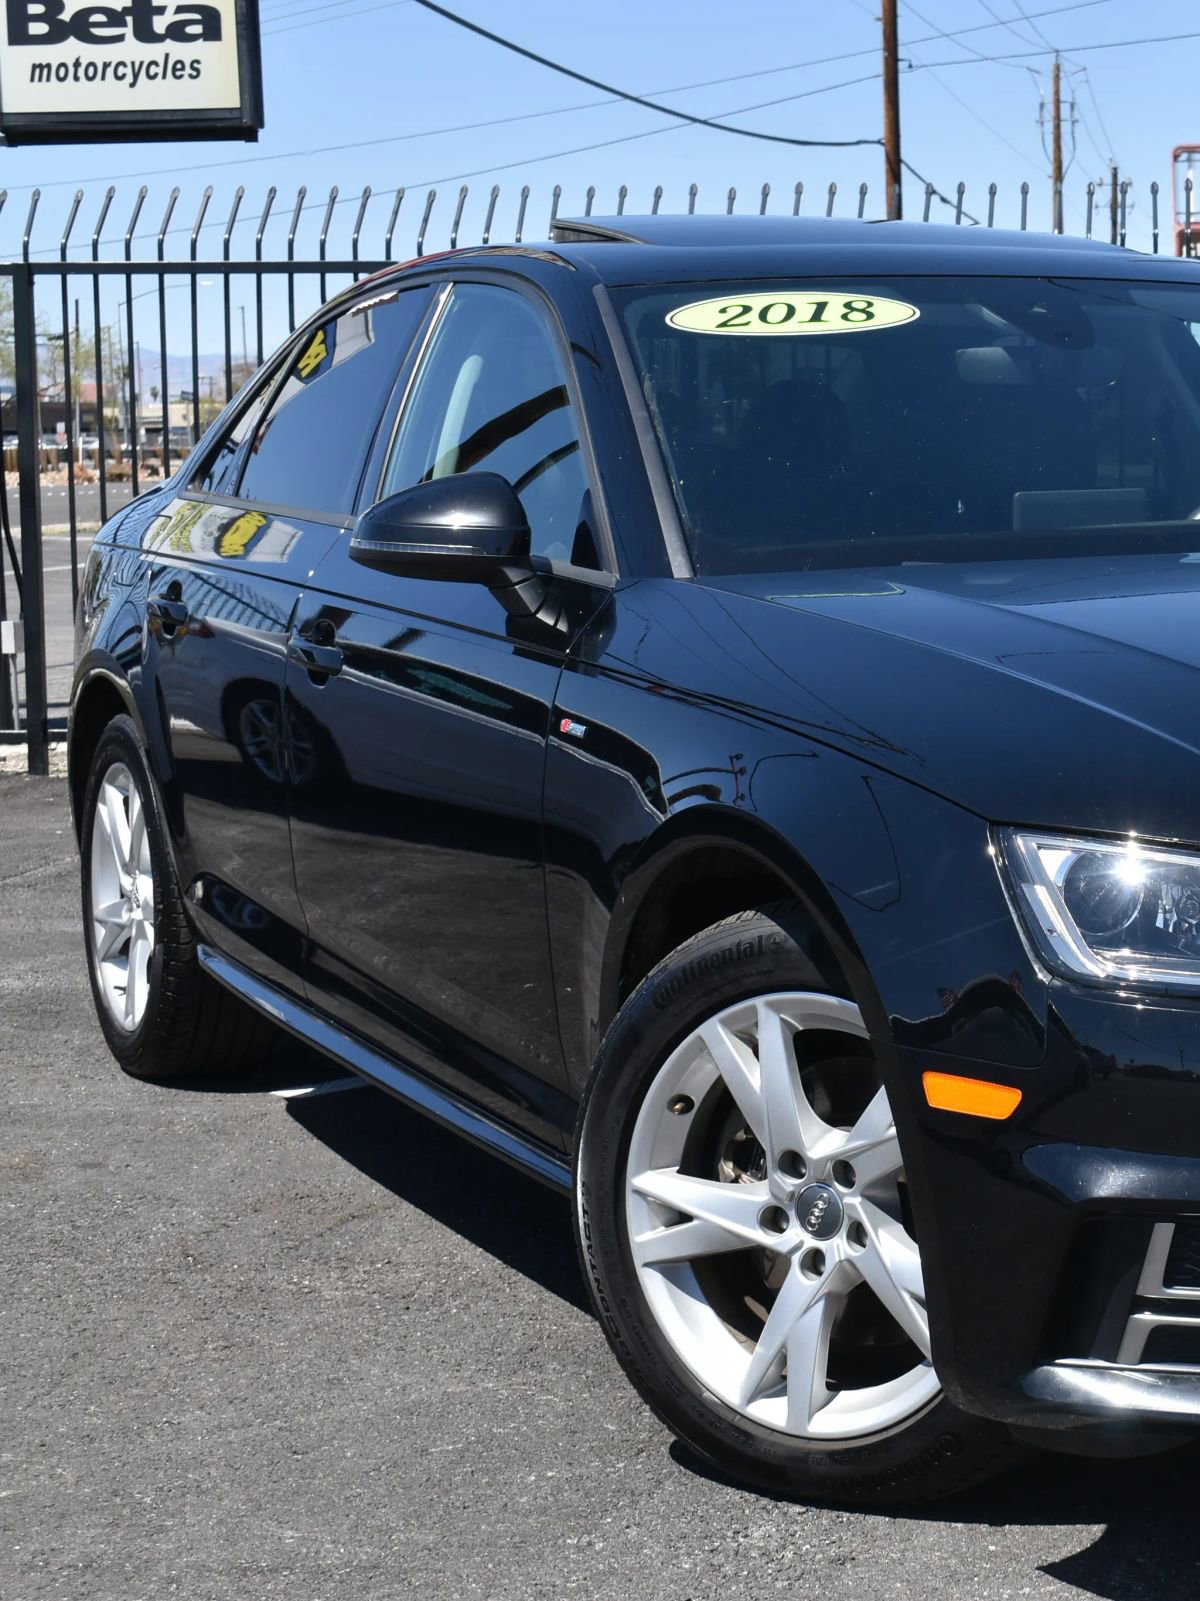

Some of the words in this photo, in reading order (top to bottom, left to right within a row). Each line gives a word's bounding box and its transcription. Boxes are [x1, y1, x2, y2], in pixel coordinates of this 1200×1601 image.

[6, 0, 223, 46] Beta
[30, 53, 202, 88] motorcycles
[715, 299, 876, 329] 2018
